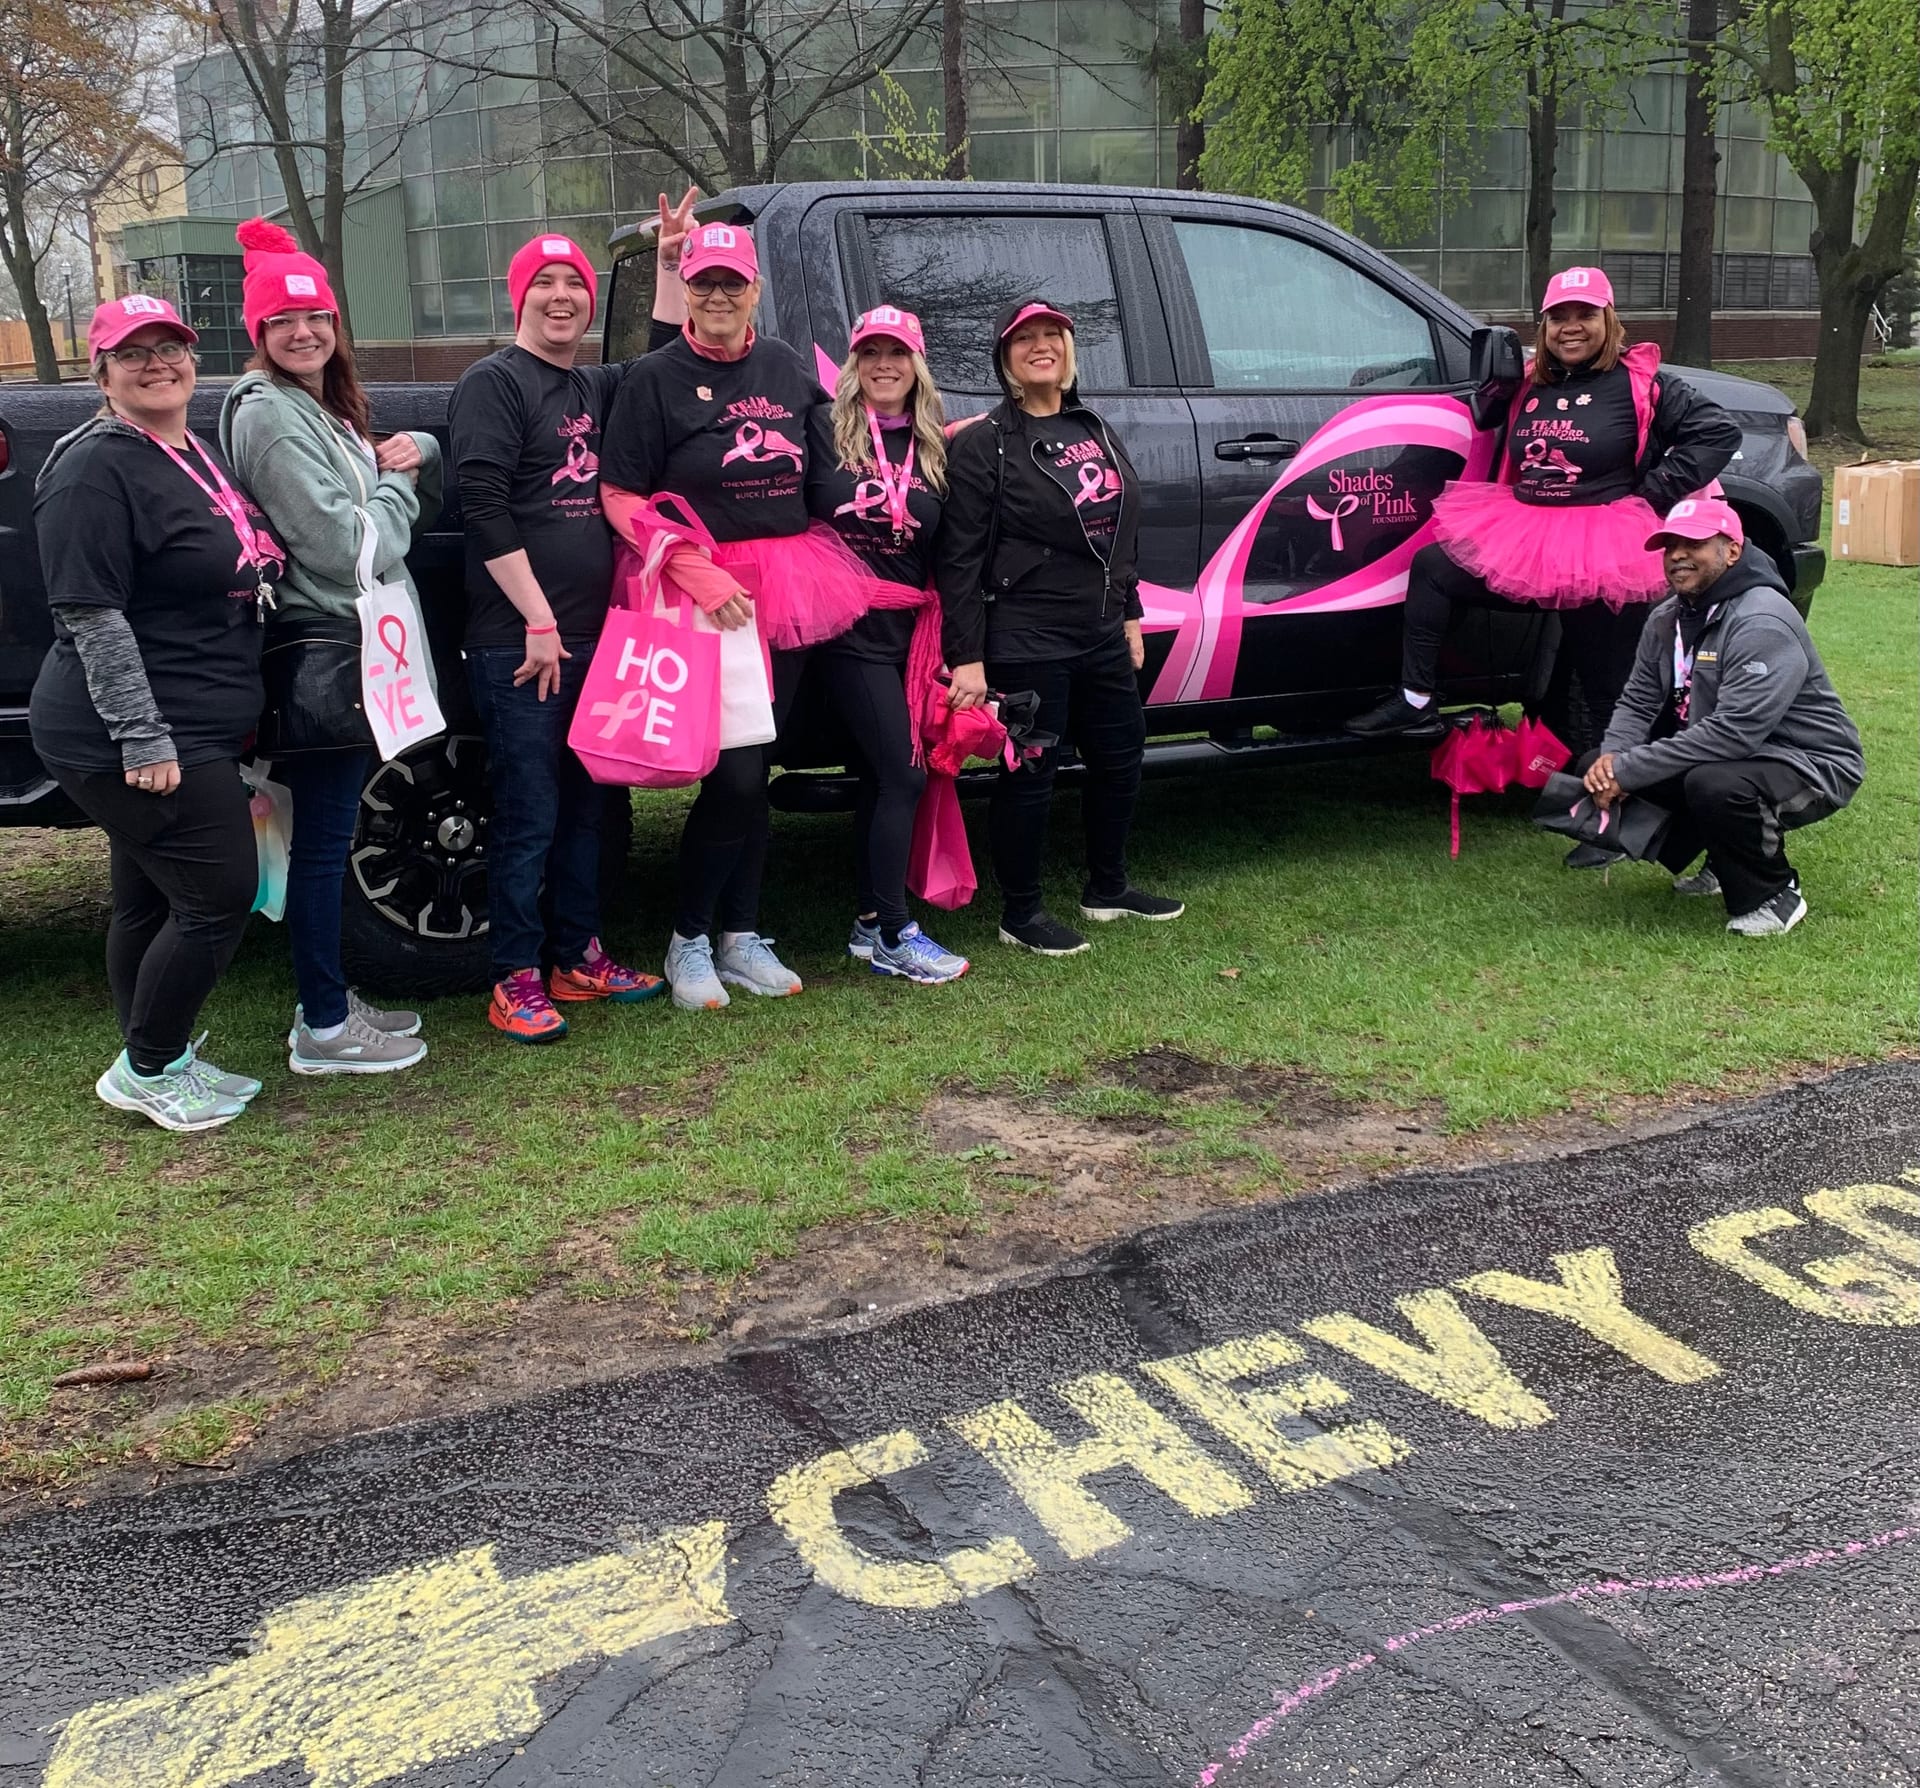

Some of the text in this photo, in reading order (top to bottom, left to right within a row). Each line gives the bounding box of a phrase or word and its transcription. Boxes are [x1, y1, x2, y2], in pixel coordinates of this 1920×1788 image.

[1531, 420, 1573, 431] TEAM
[1516, 429, 1584, 437] LES STANFORD
[1064, 440, 1100, 457] TEAM
[1055, 457, 1072, 467] LES
[1328, 467, 1394, 494] Shades
[768, 486, 798, 497] GMC
[1360, 490, 1417, 516] of Pink
[1372, 515, 1418, 525] FOUNDATION
[615, 637, 689, 693] HO
[767, 1246, 1722, 1607] CHEVY
